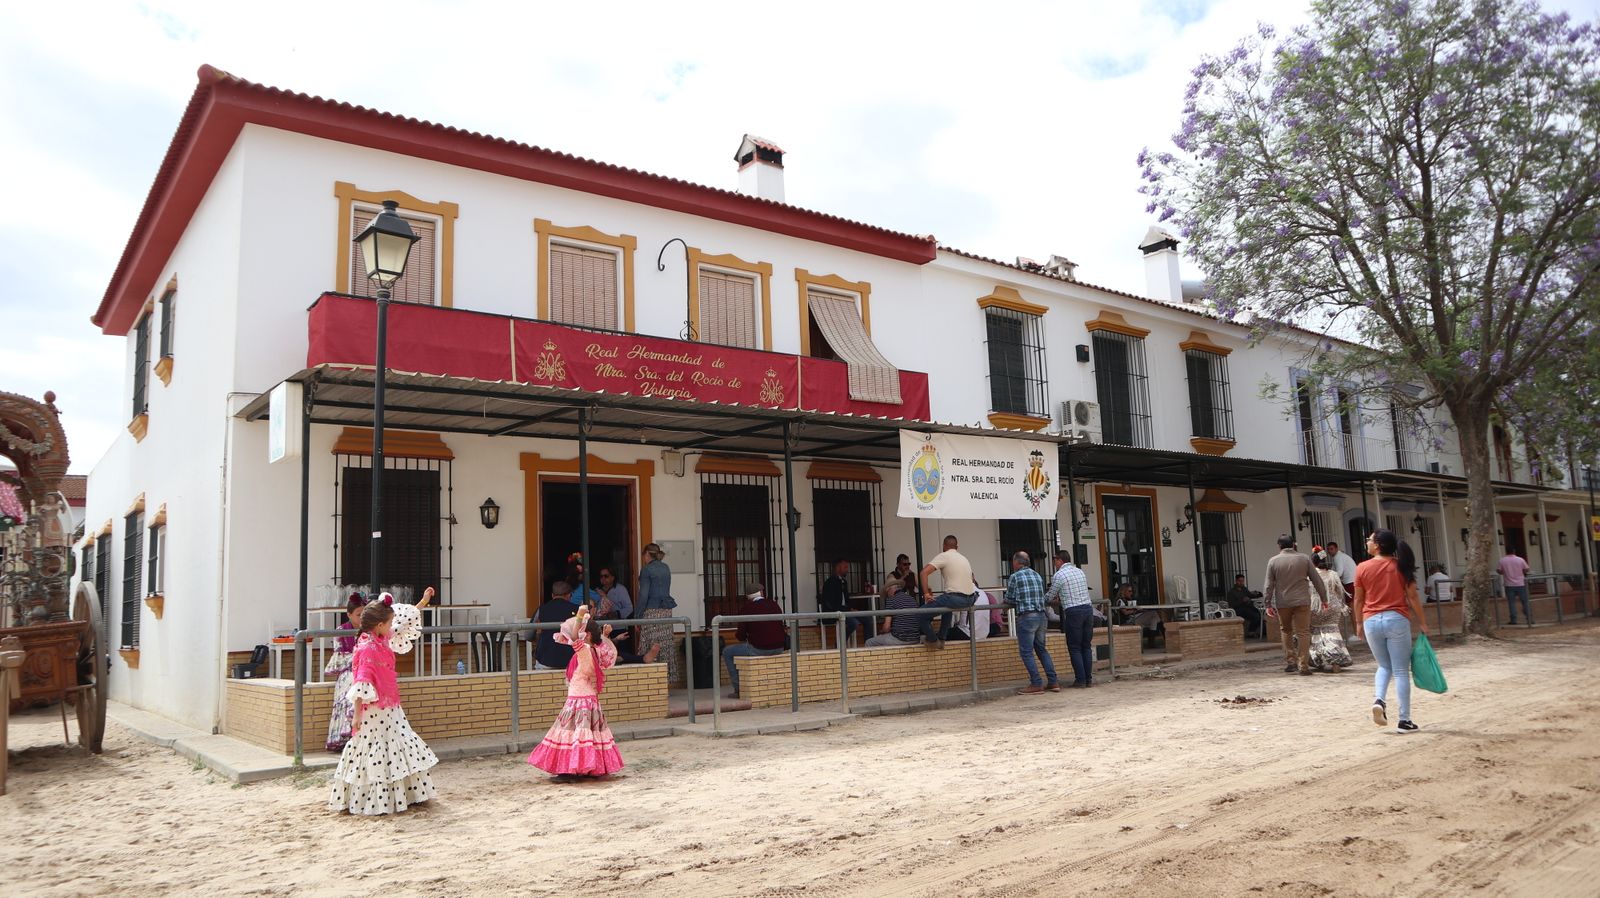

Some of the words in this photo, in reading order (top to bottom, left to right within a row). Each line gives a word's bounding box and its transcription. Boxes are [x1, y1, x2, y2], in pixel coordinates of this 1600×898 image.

[585, 343, 619, 360] Real
[627, 344, 703, 366] Hermandad
[711, 358, 726, 369] de
[595, 363, 627, 378] Ntra.
[634, 366, 661, 380] Sra.
[666, 370, 684, 382] del
[727, 377, 742, 389] de
[640, 382, 693, 399] Valencia
[952, 458, 968, 467] REAL
[969, 459, 1005, 469] HERMANDAD
[1006, 461, 1015, 469] DE
[951, 475, 970, 483] NTRA.
[971, 476, 985, 484] SRA.
[986, 476, 997, 484] DEL
[970, 492, 999, 500] VALENCIA
